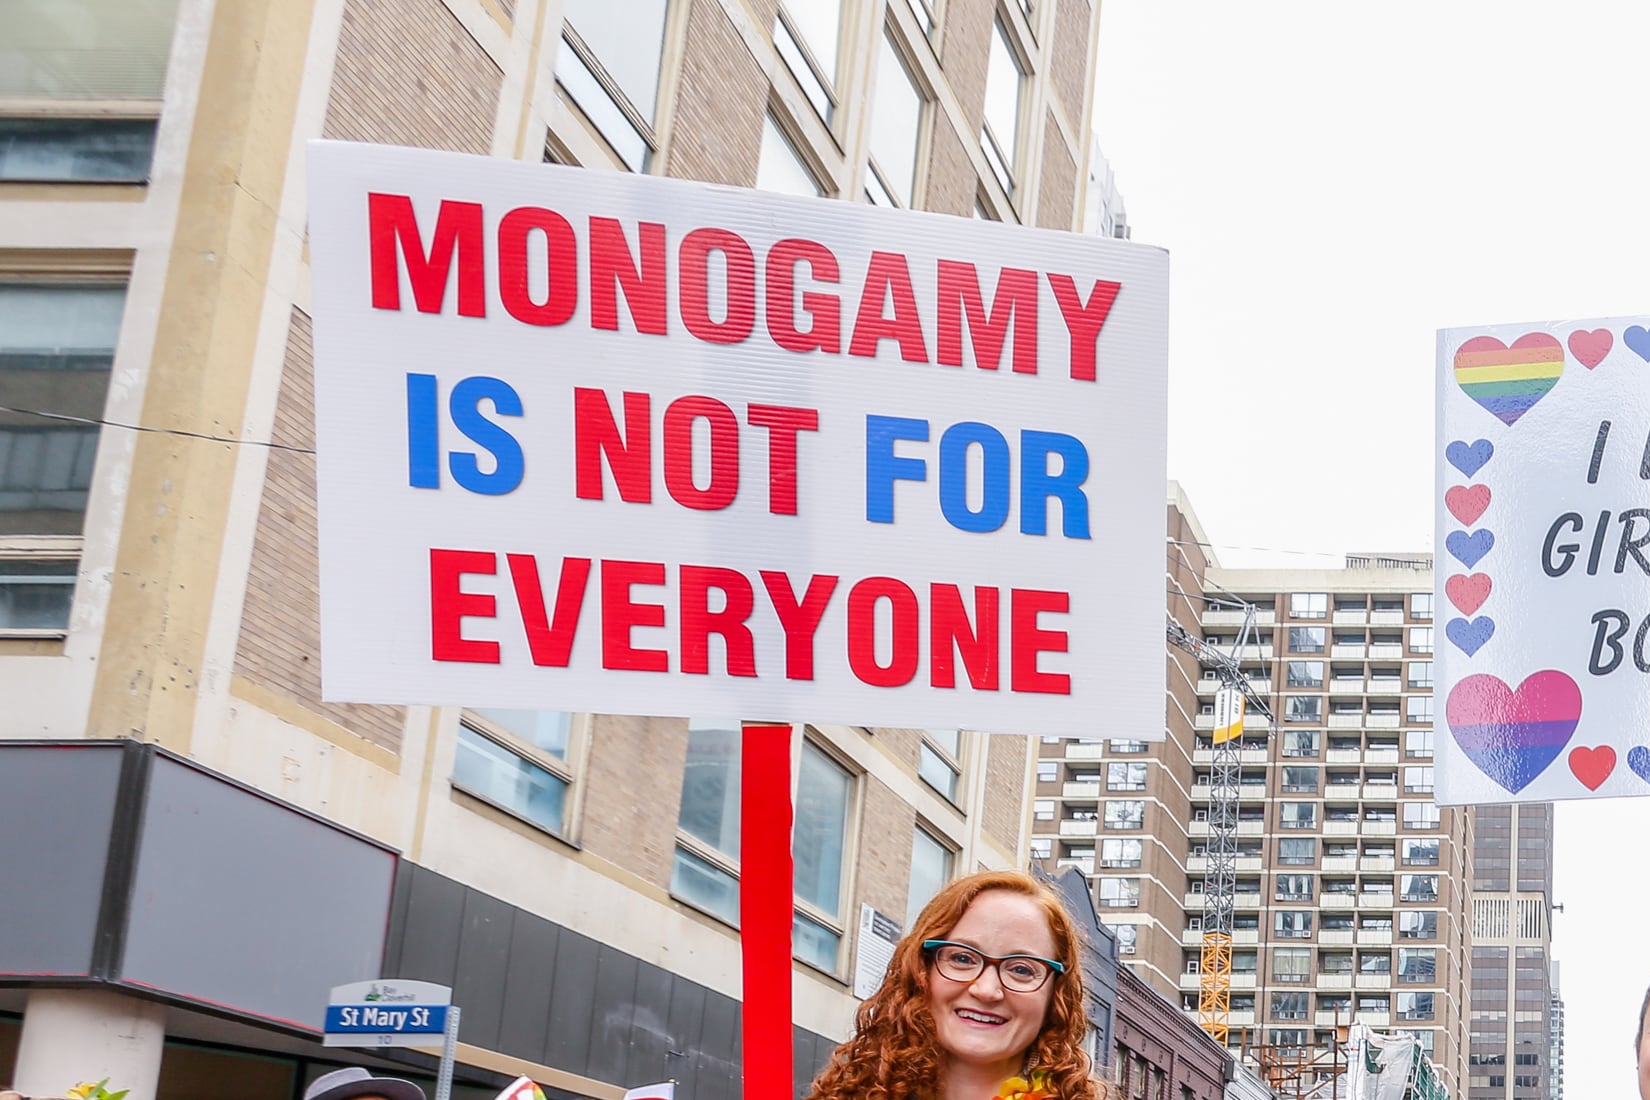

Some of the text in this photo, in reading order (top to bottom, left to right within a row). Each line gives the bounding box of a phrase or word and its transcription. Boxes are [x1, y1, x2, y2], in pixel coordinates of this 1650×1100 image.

[367, 192, 1122, 383] MONOGAMY
[406, 372, 1092, 540] IS NOT FOR
[1587, 419, 1612, 484] I
[429, 547, 1072, 696] EVERYONE
[339, 1007, 431, 1031] St Mary St
